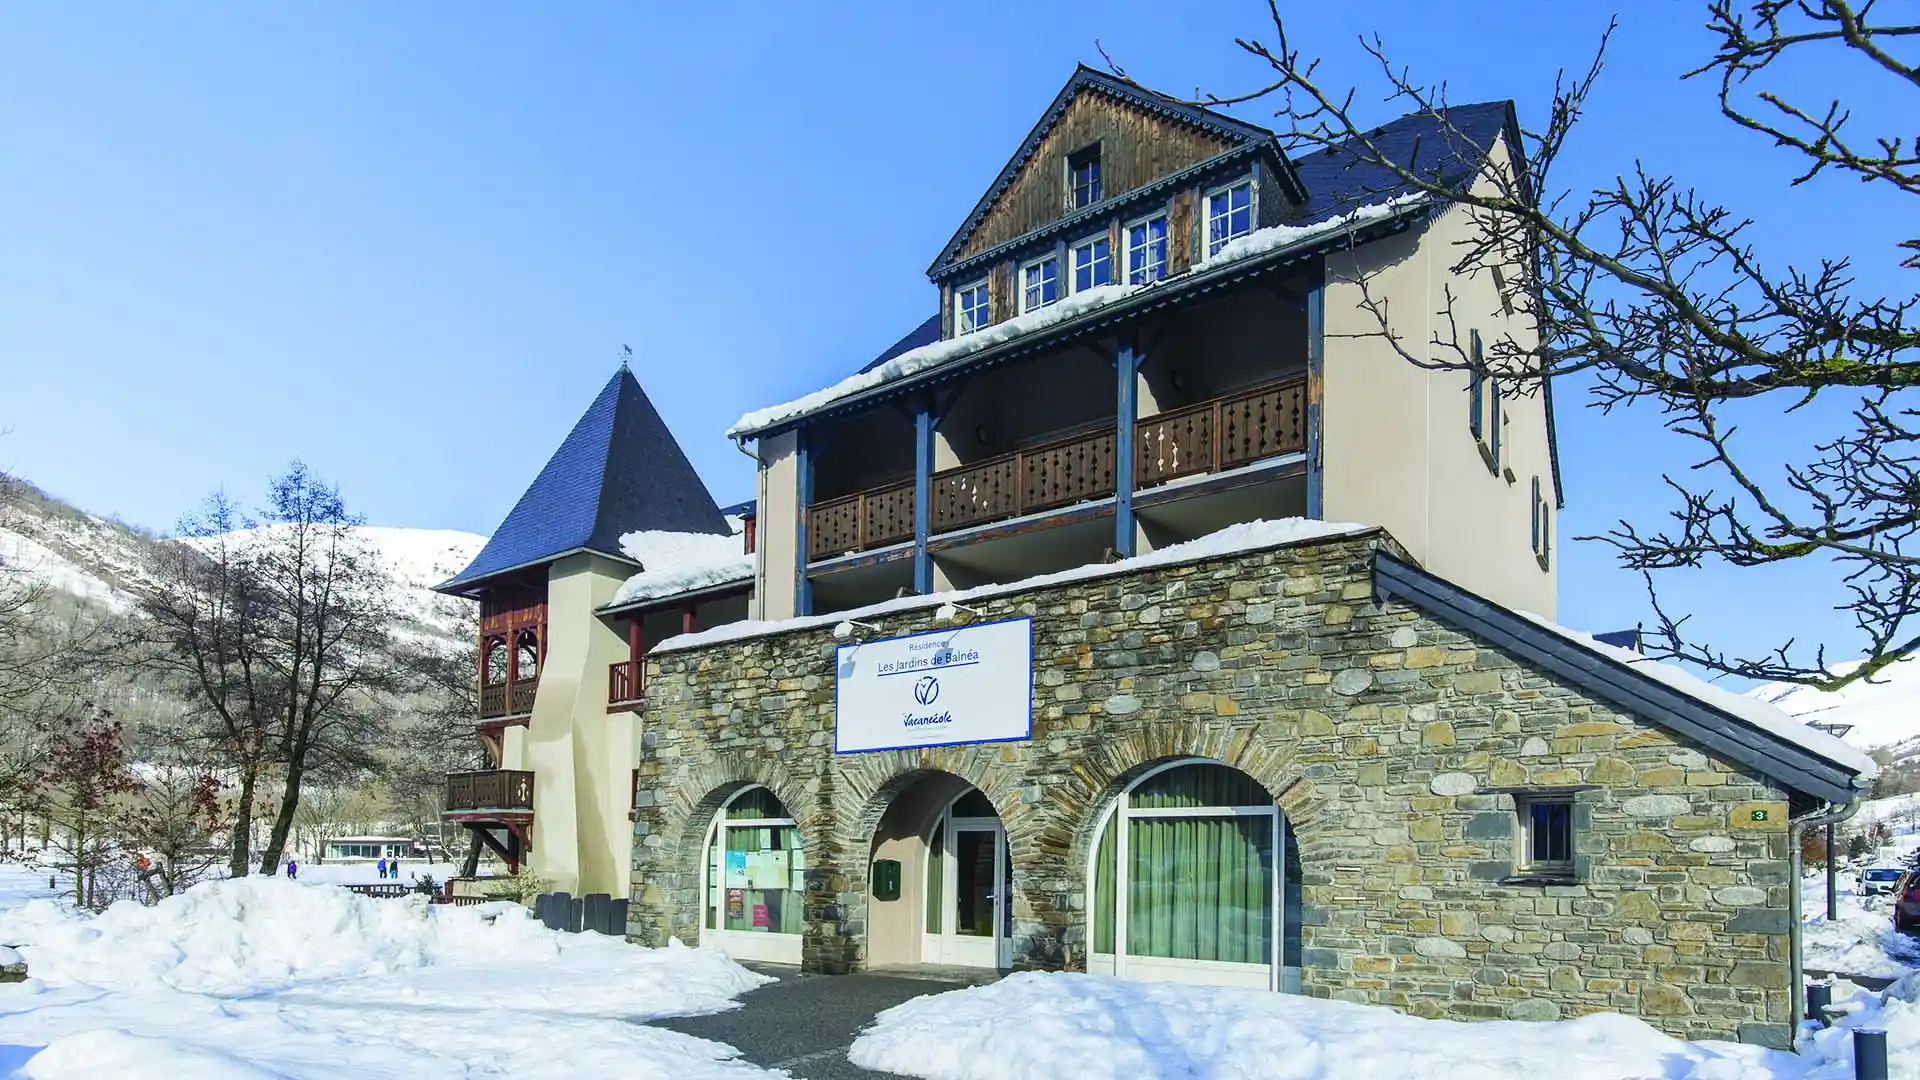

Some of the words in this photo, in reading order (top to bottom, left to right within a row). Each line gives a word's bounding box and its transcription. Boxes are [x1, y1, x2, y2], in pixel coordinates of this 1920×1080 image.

[909, 641, 946, 652] Résidence
[878, 662, 894, 673] Les
[896, 657, 928, 671] Jardins
[930, 653, 943, 665] de
[945, 649, 979, 663] Balnéa
[1755, 811, 1764, 820] 3
